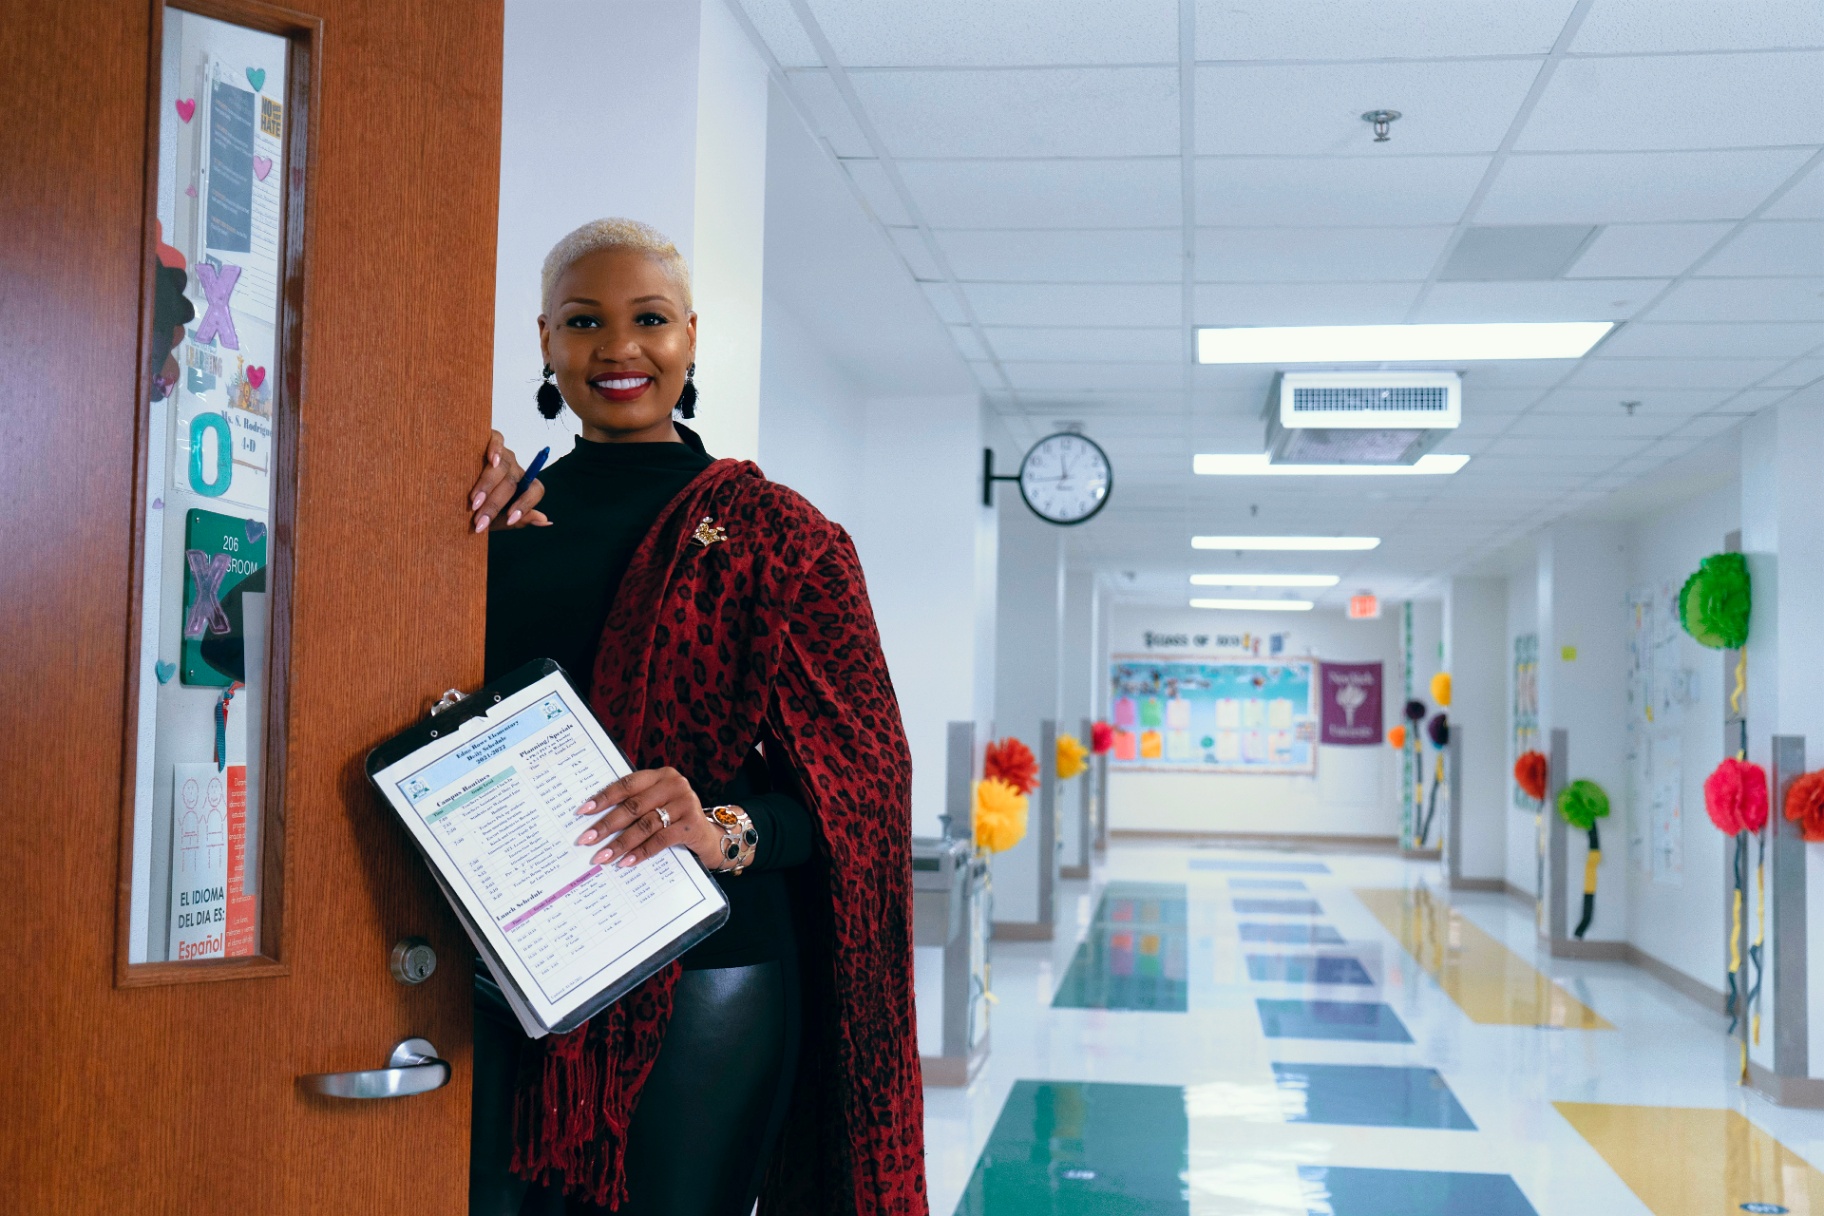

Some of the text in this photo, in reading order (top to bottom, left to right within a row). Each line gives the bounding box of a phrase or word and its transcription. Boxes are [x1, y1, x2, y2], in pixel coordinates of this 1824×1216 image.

[261, 116, 281, 137] HATE
[223, 535, 239, 552] 206
[205, 554, 258, 575] LSROOM
[487, 719, 520, 740] Elementary
[518, 722, 574, 758] Planning/Specials
[475, 743, 506, 764] 2021-2022
[481, 734, 507, 752] Schedule
[435, 789, 462, 808] Campus
[461, 772, 490, 792] Routines
[180, 892, 189, 906] EL
[192, 886, 224, 904] IDIOMA
[495, 905, 516, 921] Lunch
[515, 888, 544, 908] Schedule
[178, 907, 225, 928] DEL DIA ES:
[178, 933, 223, 960] Español
